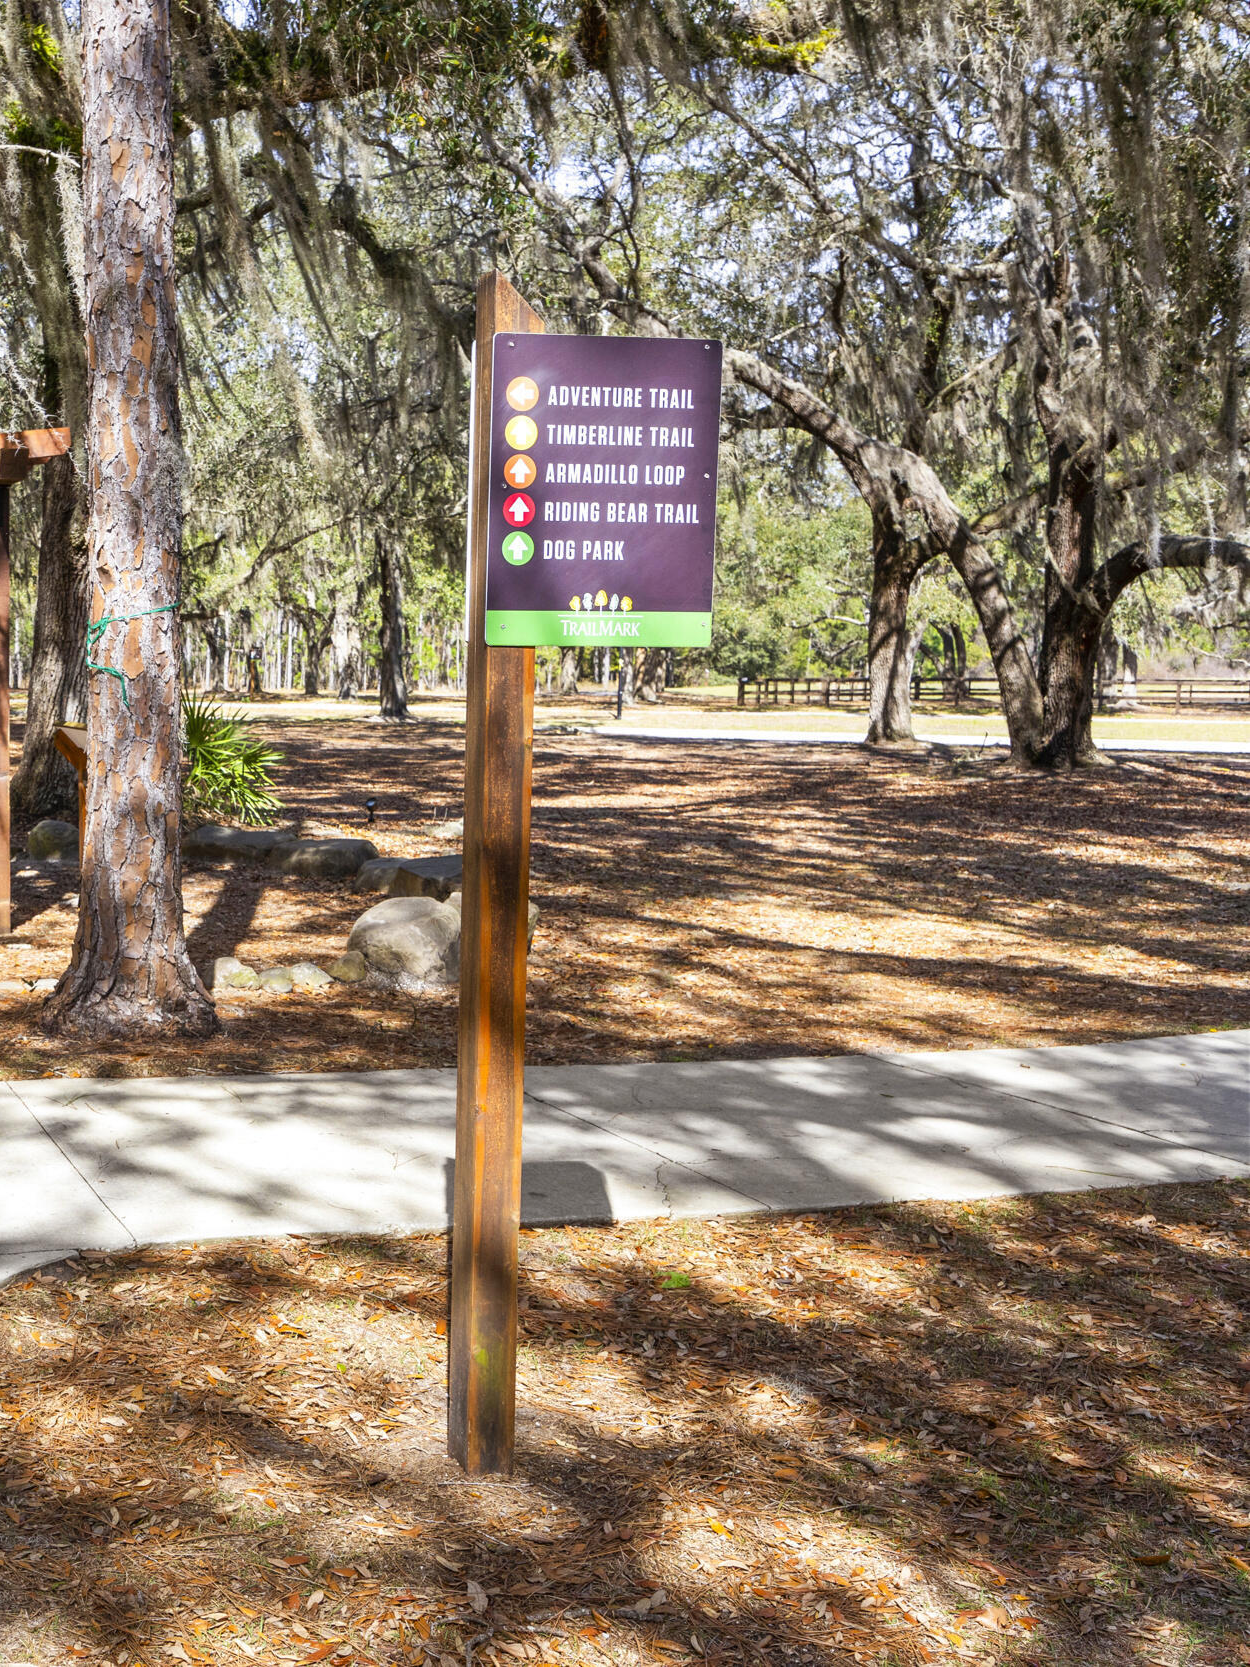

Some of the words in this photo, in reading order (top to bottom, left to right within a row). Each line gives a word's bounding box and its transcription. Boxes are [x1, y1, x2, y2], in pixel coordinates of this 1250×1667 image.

[547, 385, 643, 408] ADVENTURE
[649, 388, 695, 410] TRAIL
[547, 424, 643, 447] TIMBERLINE
[649, 426, 695, 448] TRAIL
[545, 463, 638, 485] ARMADILLO
[644, 465, 686, 486] LOOP
[544, 502, 600, 523] RIDING
[606, 503, 648, 524] BEAR
[654, 504, 699, 525] TRAIL
[543, 540, 576, 561] DOG
[582, 541, 625, 561] PARK
